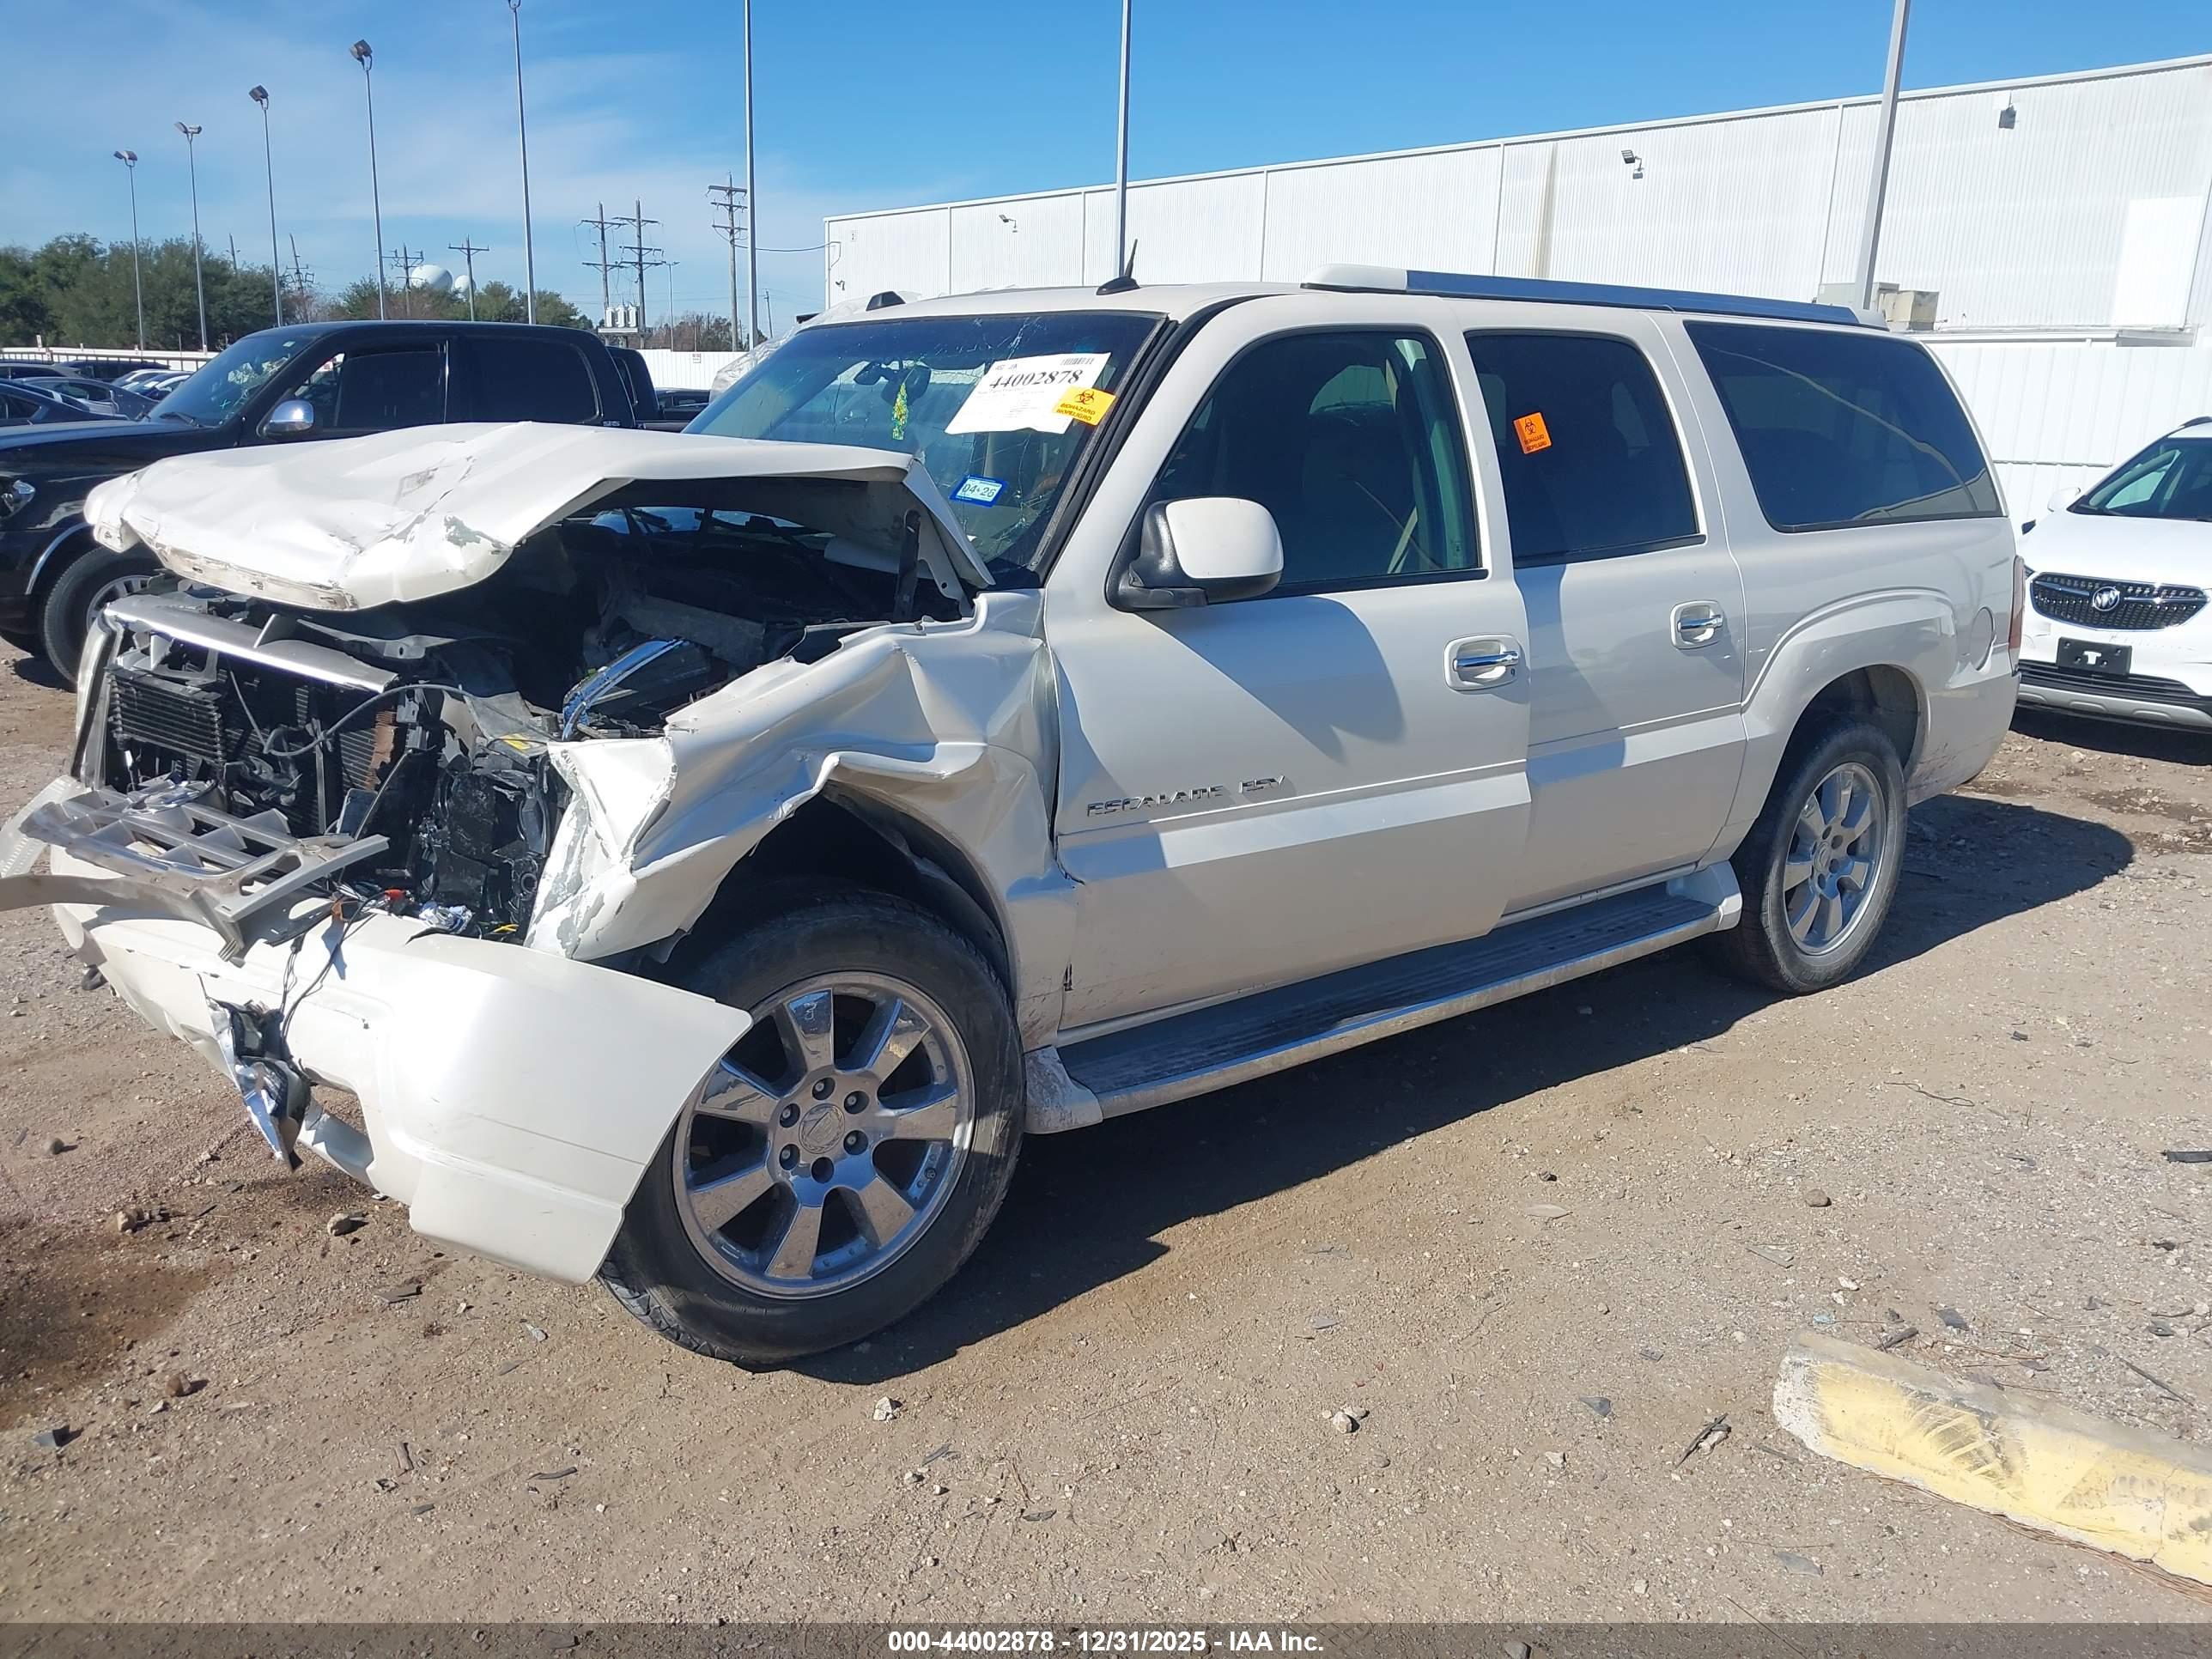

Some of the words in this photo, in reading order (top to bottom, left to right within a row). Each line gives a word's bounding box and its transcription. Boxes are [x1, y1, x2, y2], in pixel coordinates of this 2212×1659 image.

[989, 369, 1084, 388] 44002878
[1060, 403, 1096, 416] BIOHAZARD
[1238, 775, 1285, 794] ESV
